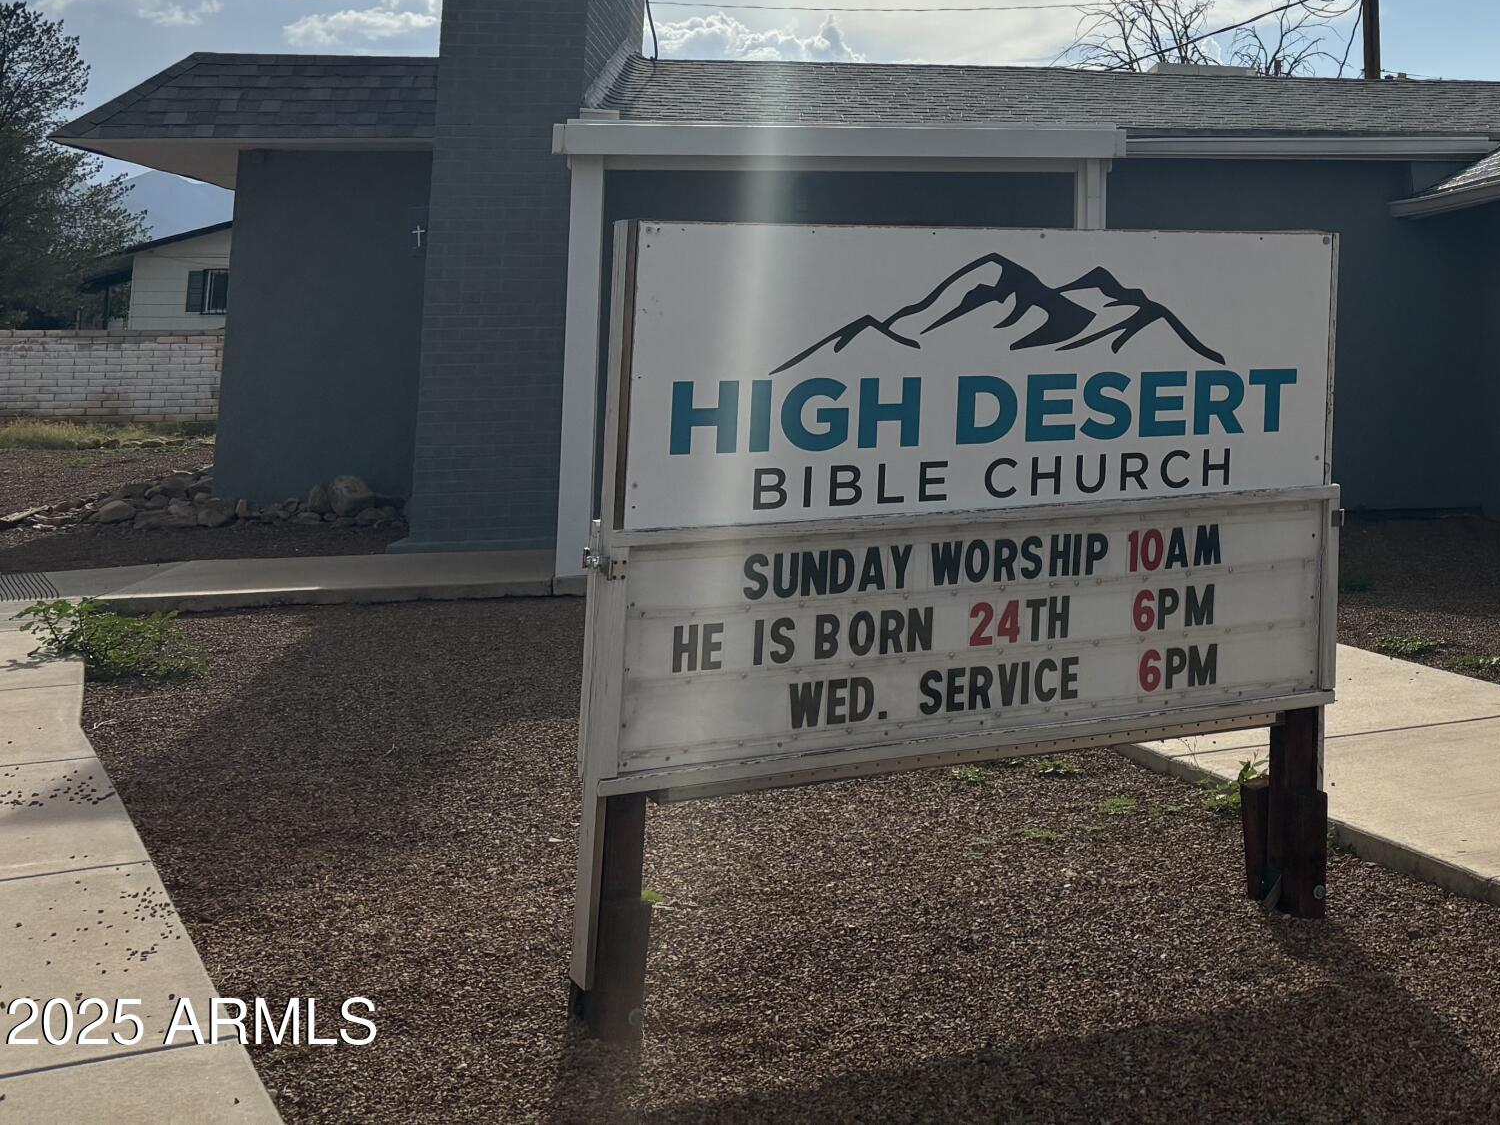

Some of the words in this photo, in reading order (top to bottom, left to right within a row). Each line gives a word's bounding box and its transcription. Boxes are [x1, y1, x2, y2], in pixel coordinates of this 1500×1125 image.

[669, 377, 921, 455] HIGH
[955, 369, 1297, 445] DESERT
[753, 460, 948, 510] BIBLE
[984, 448, 1231, 499] CHURCH
[743, 545, 910, 601] SUNDAY
[931, 532, 1110, 586] WORSHIP
[1127, 524, 1221, 572] 10AM
[672, 623, 723, 673] HE
[753, 618, 796, 665] IS
[814, 607, 933, 660] BORN
[968, 596, 1070, 647] 24TH
[1132, 584, 1215, 633] 6PM
[789, 678, 887, 729] WED.
[919, 657, 1079, 715] SERVICE
[1138, 644, 1218, 692] 6PM
